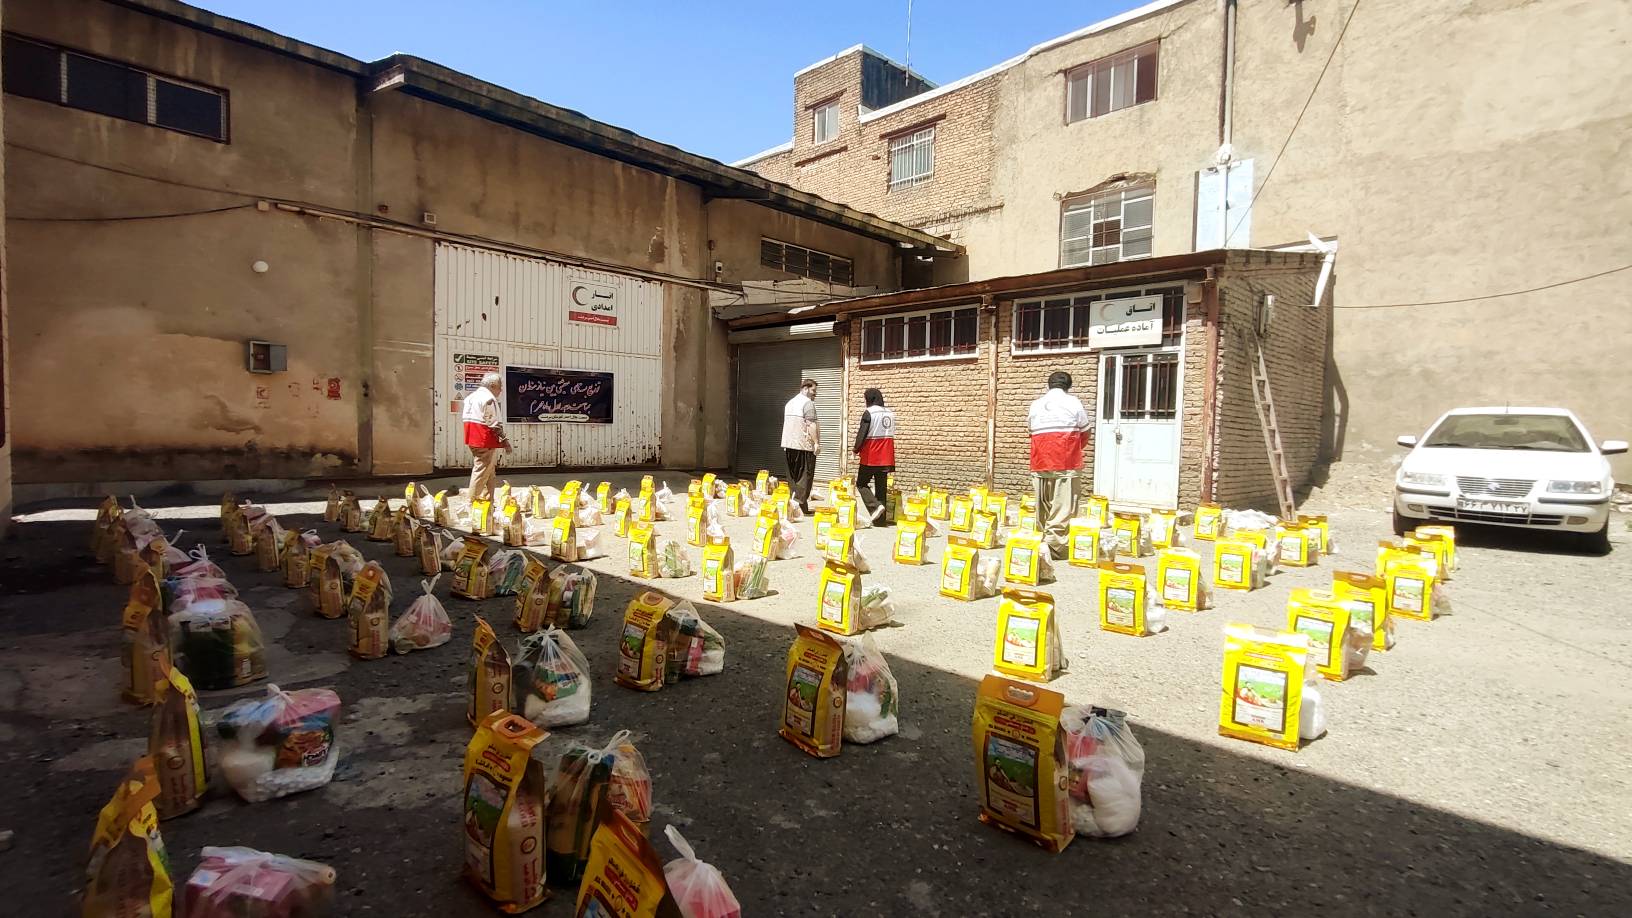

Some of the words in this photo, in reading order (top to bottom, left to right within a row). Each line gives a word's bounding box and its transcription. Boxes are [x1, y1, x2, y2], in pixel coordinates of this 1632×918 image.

[591, 290, 613, 301] انبار
[591, 303, 613, 312] امدادی
[1125, 302, 1156, 317] اتاق
[1096, 324, 1130, 335] عملیات
[1131, 320, 1154, 332] آماده
